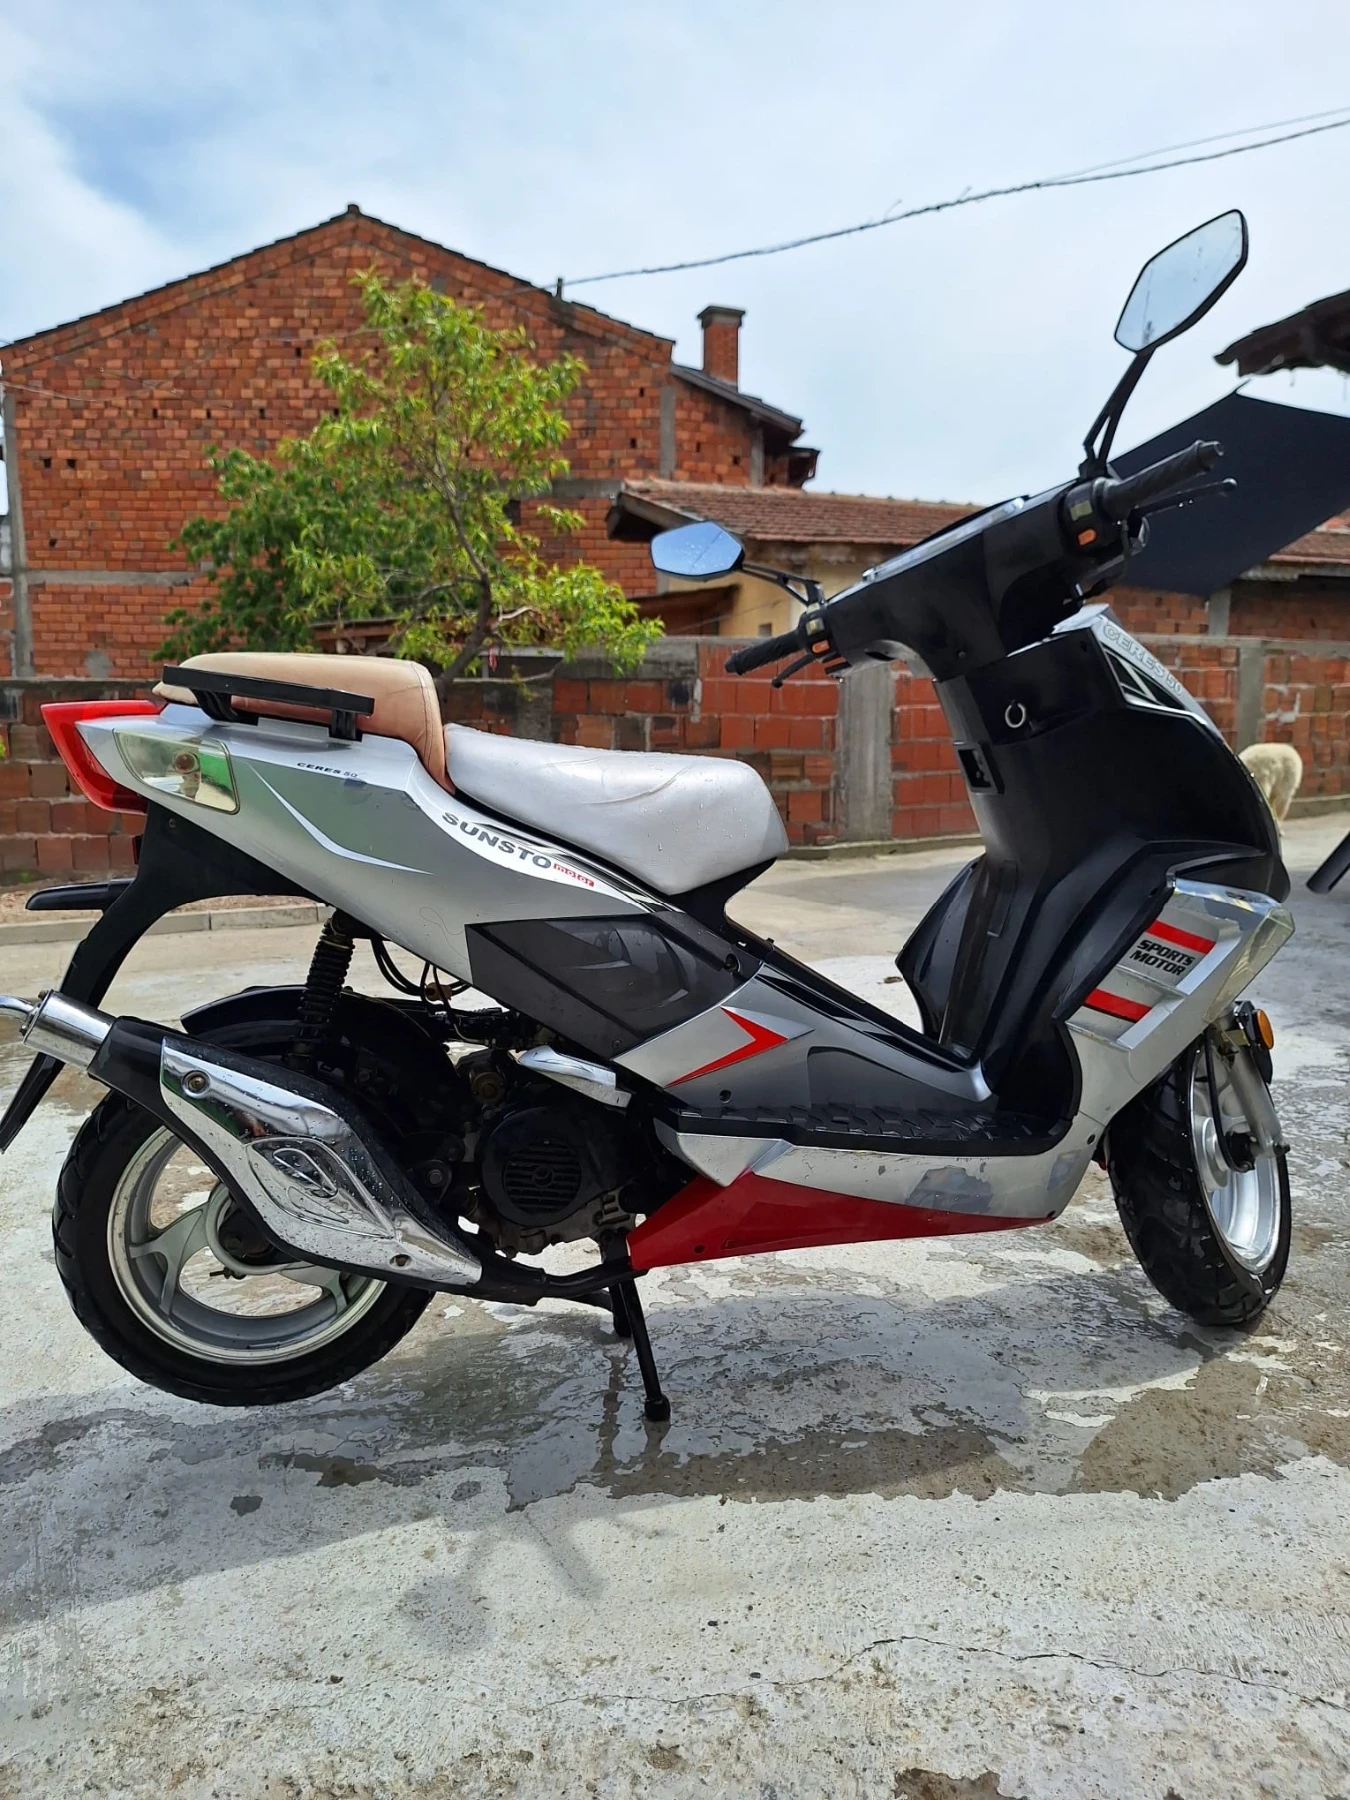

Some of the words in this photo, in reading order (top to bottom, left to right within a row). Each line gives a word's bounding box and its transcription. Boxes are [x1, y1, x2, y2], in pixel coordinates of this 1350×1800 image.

[1103, 624, 1164, 677] CERES
[1166, 674, 1182, 695] 50
[297, 762, 341, 774] CERES
[442, 811, 552, 869] SUNSTO
[553, 862, 595, 887] motor
[1129, 950, 1186, 976] MOTOR
[1137, 939, 1195, 966] SPORTS
